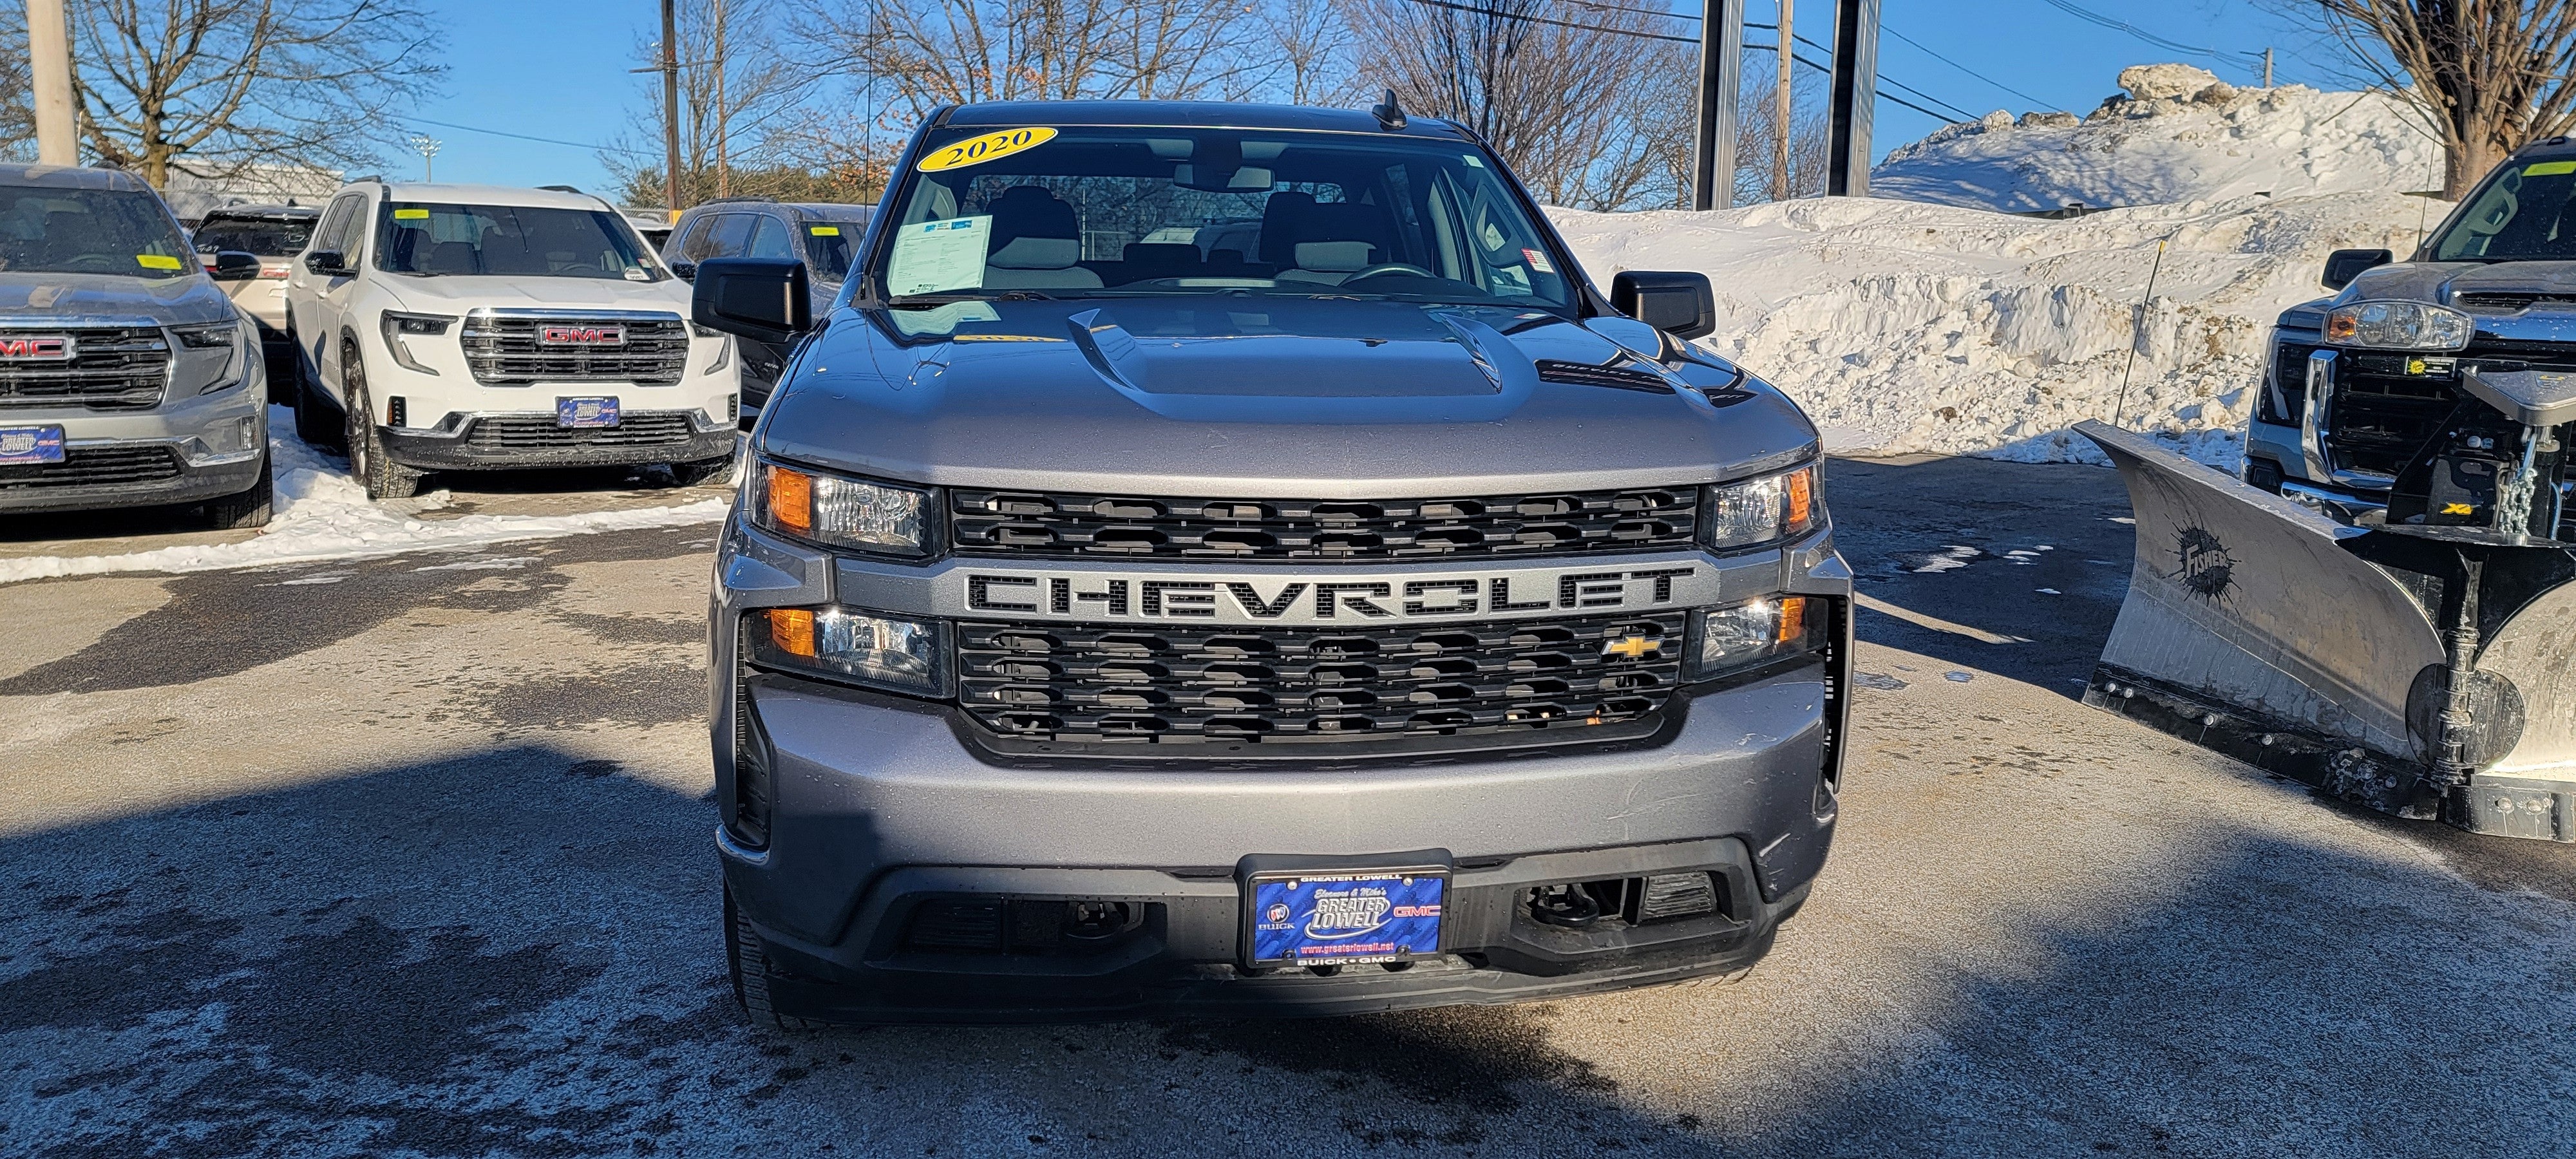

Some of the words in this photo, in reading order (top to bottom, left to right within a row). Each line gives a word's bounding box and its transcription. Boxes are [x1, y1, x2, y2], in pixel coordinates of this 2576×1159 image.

[944, 131, 1032, 166] 2020
[545, 328, 620, 343] GMC
[0, 339, 63, 357] MC
[2186, 543, 2229, 578] FISHER
[965, 567, 1696, 618] CHEVROLET
[1316, 896, 1386, 914] GREATER
[1394, 905, 1441, 917] GMC
[1310, 911, 1380, 930] LOWELL
[1300, 942, 1394, 954] www.greaterlowell.net
